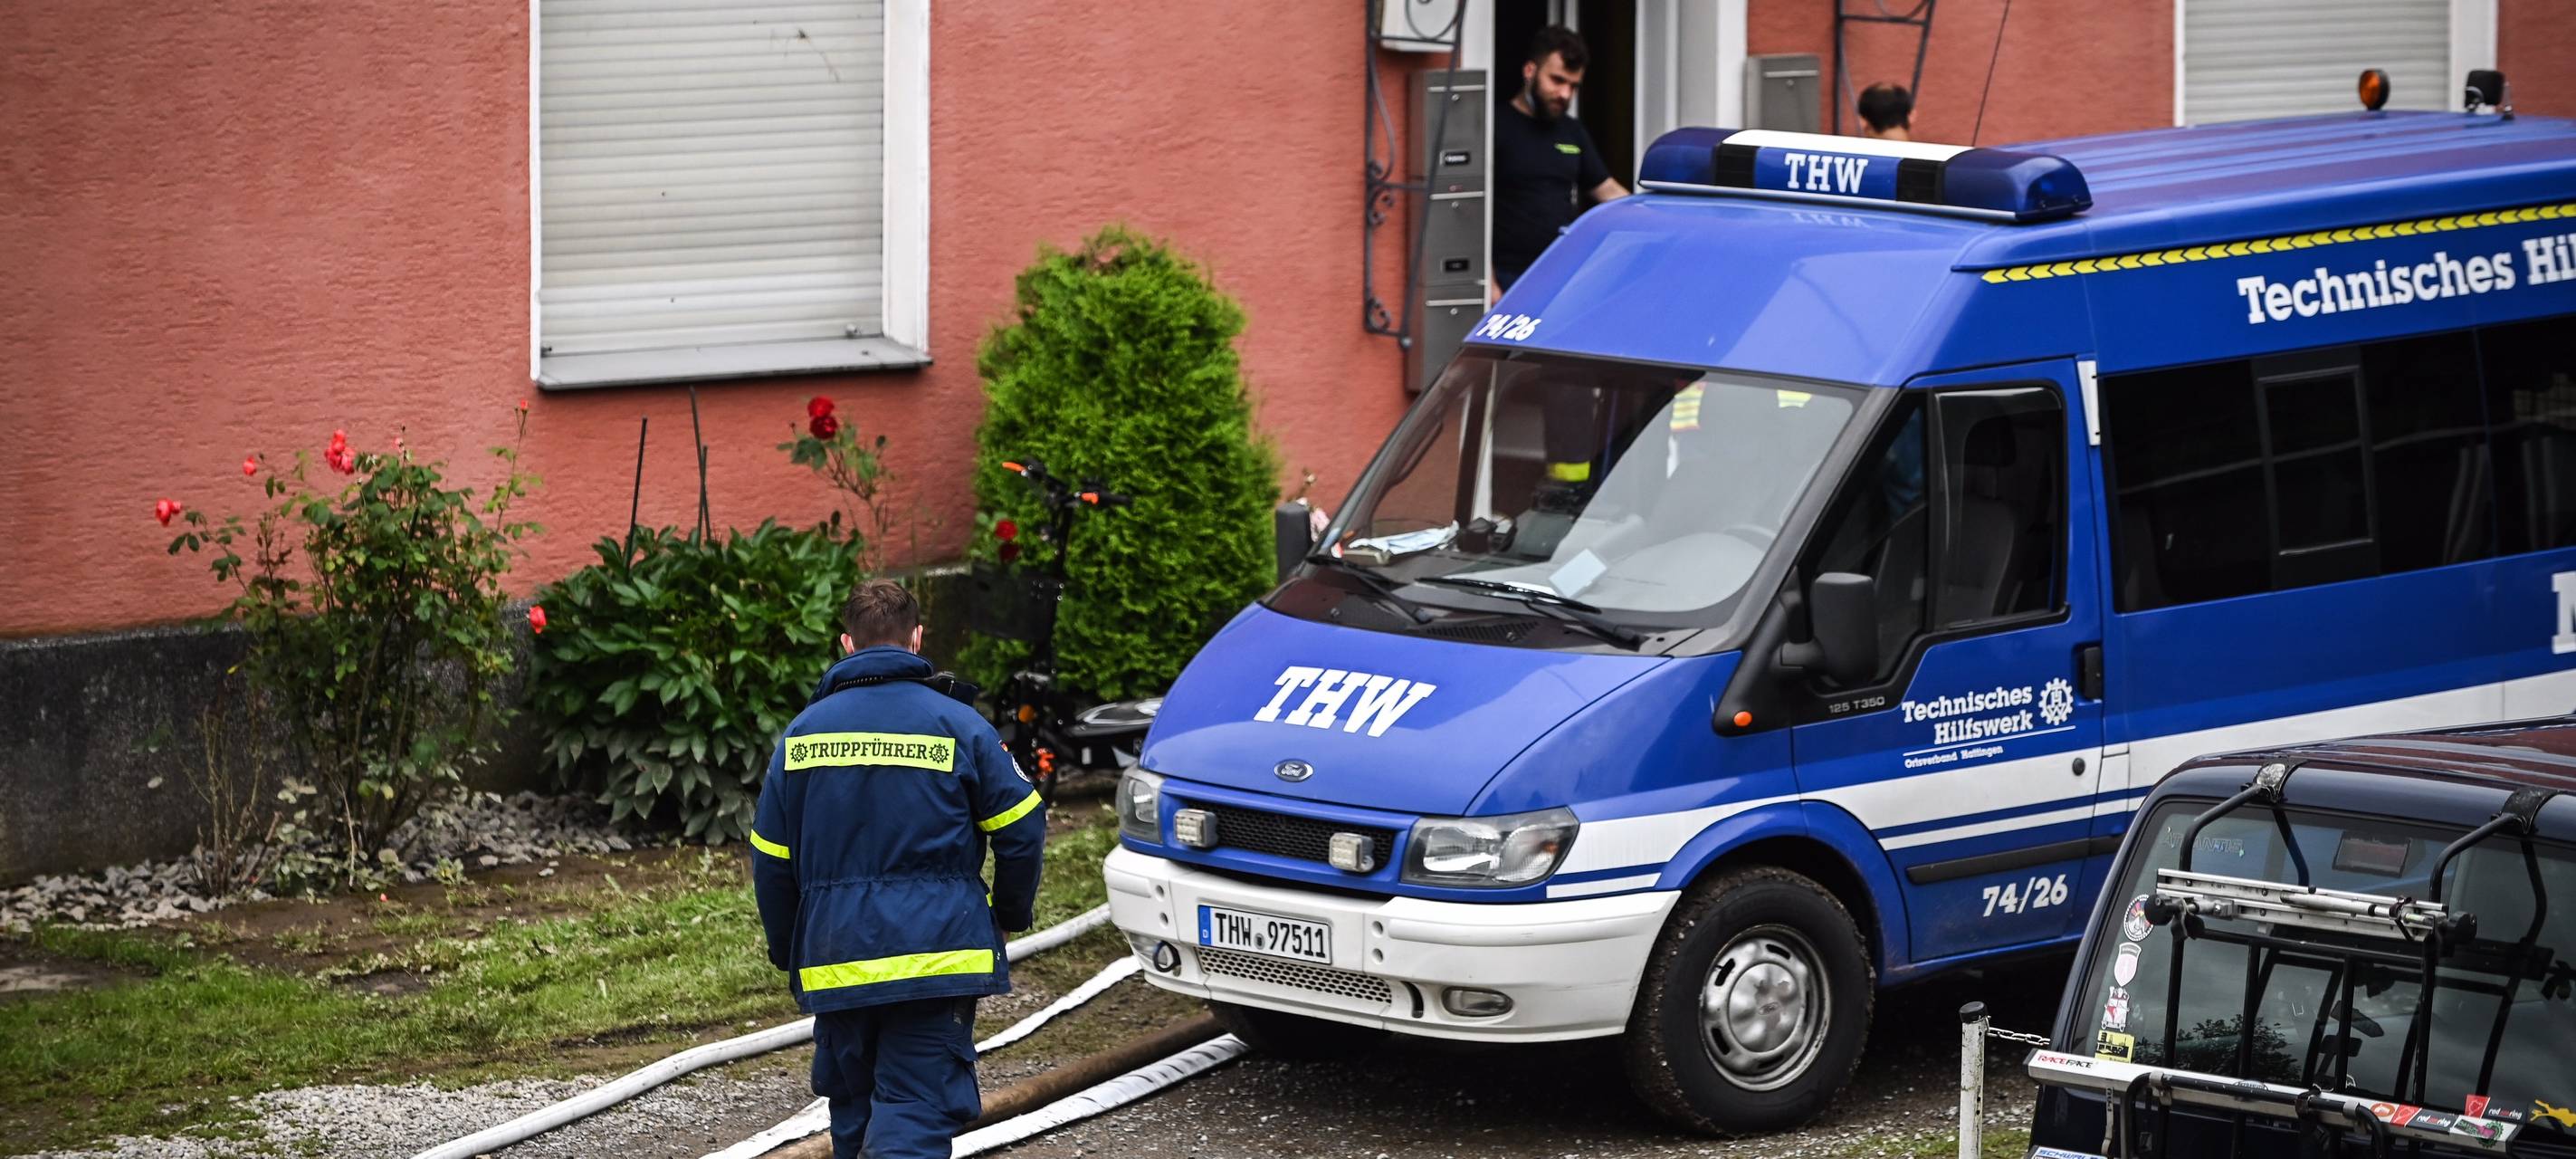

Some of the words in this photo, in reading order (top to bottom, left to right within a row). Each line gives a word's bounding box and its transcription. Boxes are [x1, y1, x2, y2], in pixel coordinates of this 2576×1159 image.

[1784, 152, 1869, 194] THW
[2237, 251, 2515, 324] Technisches
[1474, 313, 1542, 341] 74/26
[1253, 666, 1437, 738] THW
[1828, 702, 1850, 714] 125
[1853, 696, 1885, 710] T350
[1902, 685, 2033, 723] Technisches
[1933, 709, 2034, 745] Hilfswerk
[809, 738, 928, 761] TRUPPFÜHRER
[1904, 751, 1958, 769] Ortsverband
[1982, 874, 2068, 917] 74/26
[1215, 913, 1251, 946] THW
[1267, 921, 1326, 959] 97511
